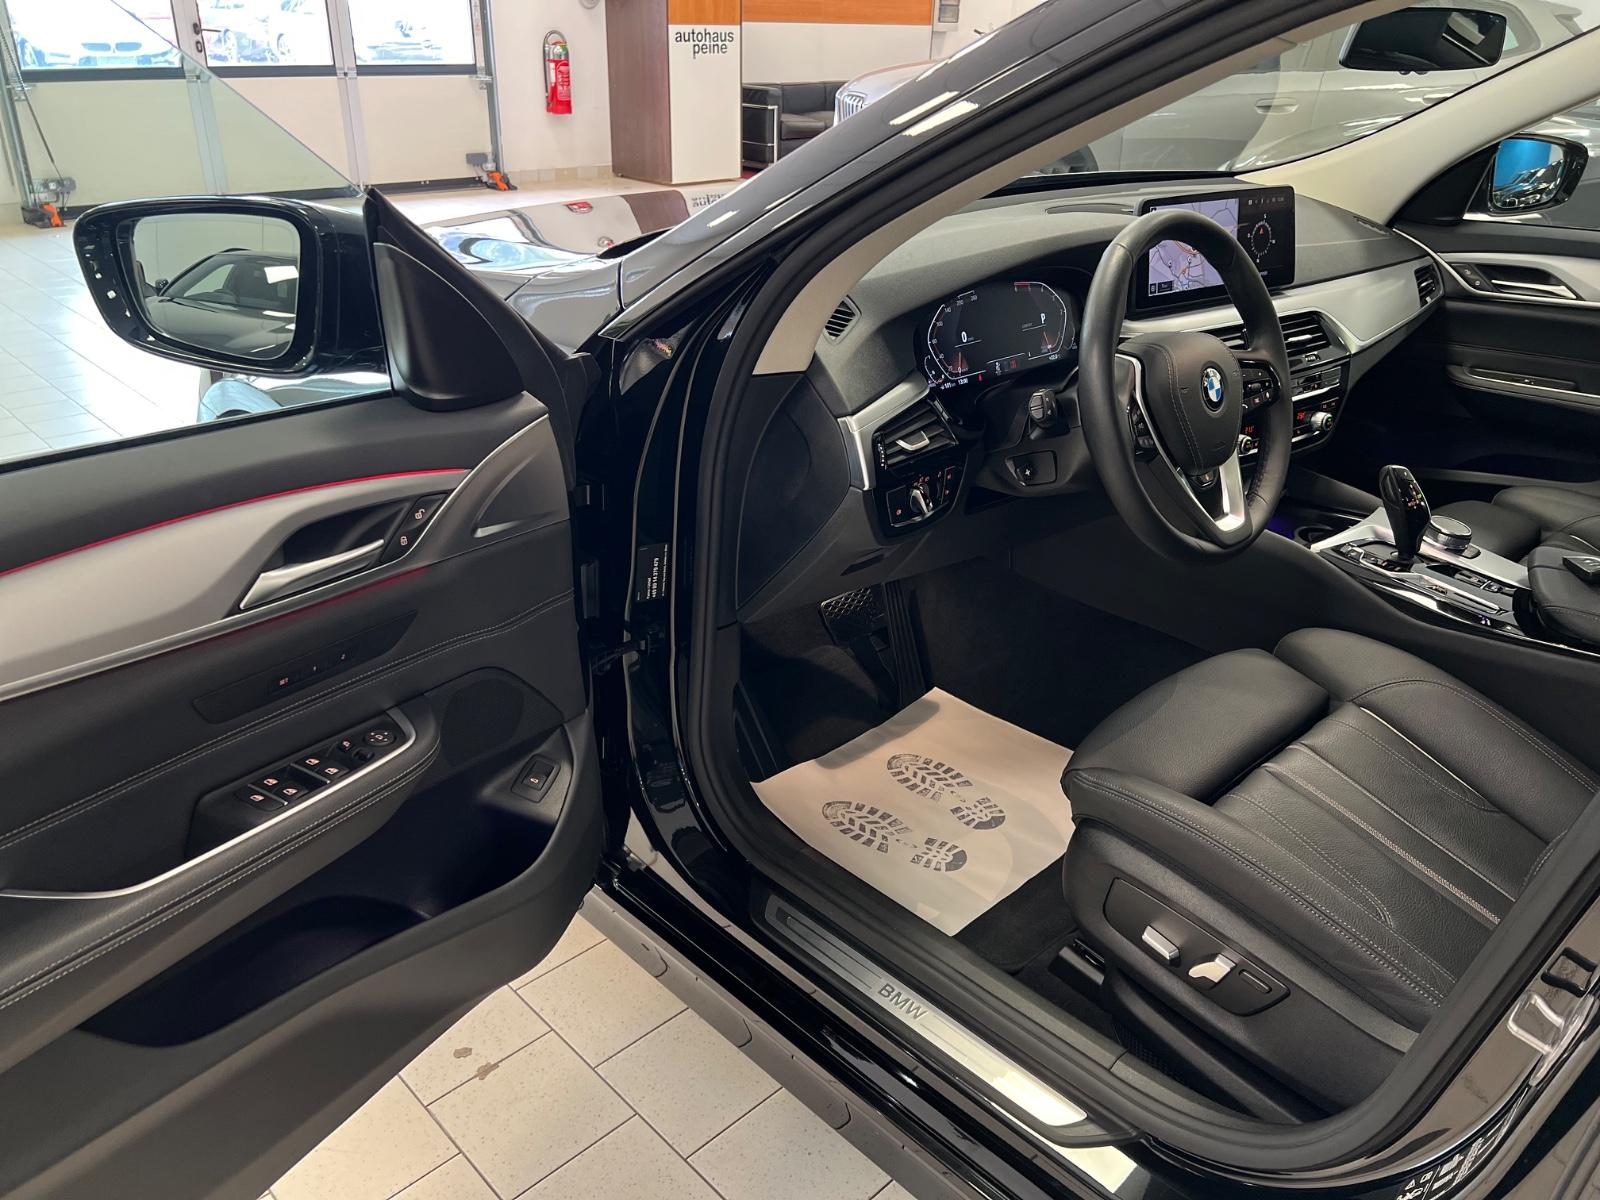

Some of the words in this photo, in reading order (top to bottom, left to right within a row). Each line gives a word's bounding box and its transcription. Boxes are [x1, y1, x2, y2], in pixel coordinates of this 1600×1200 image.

[674, 28, 735, 43] autohaus
[693, 43, 728, 59] peine
[1040, 313, 1046, 324] P
[961, 331, 968, 343] 0
[877, 982, 929, 1020] BMW
